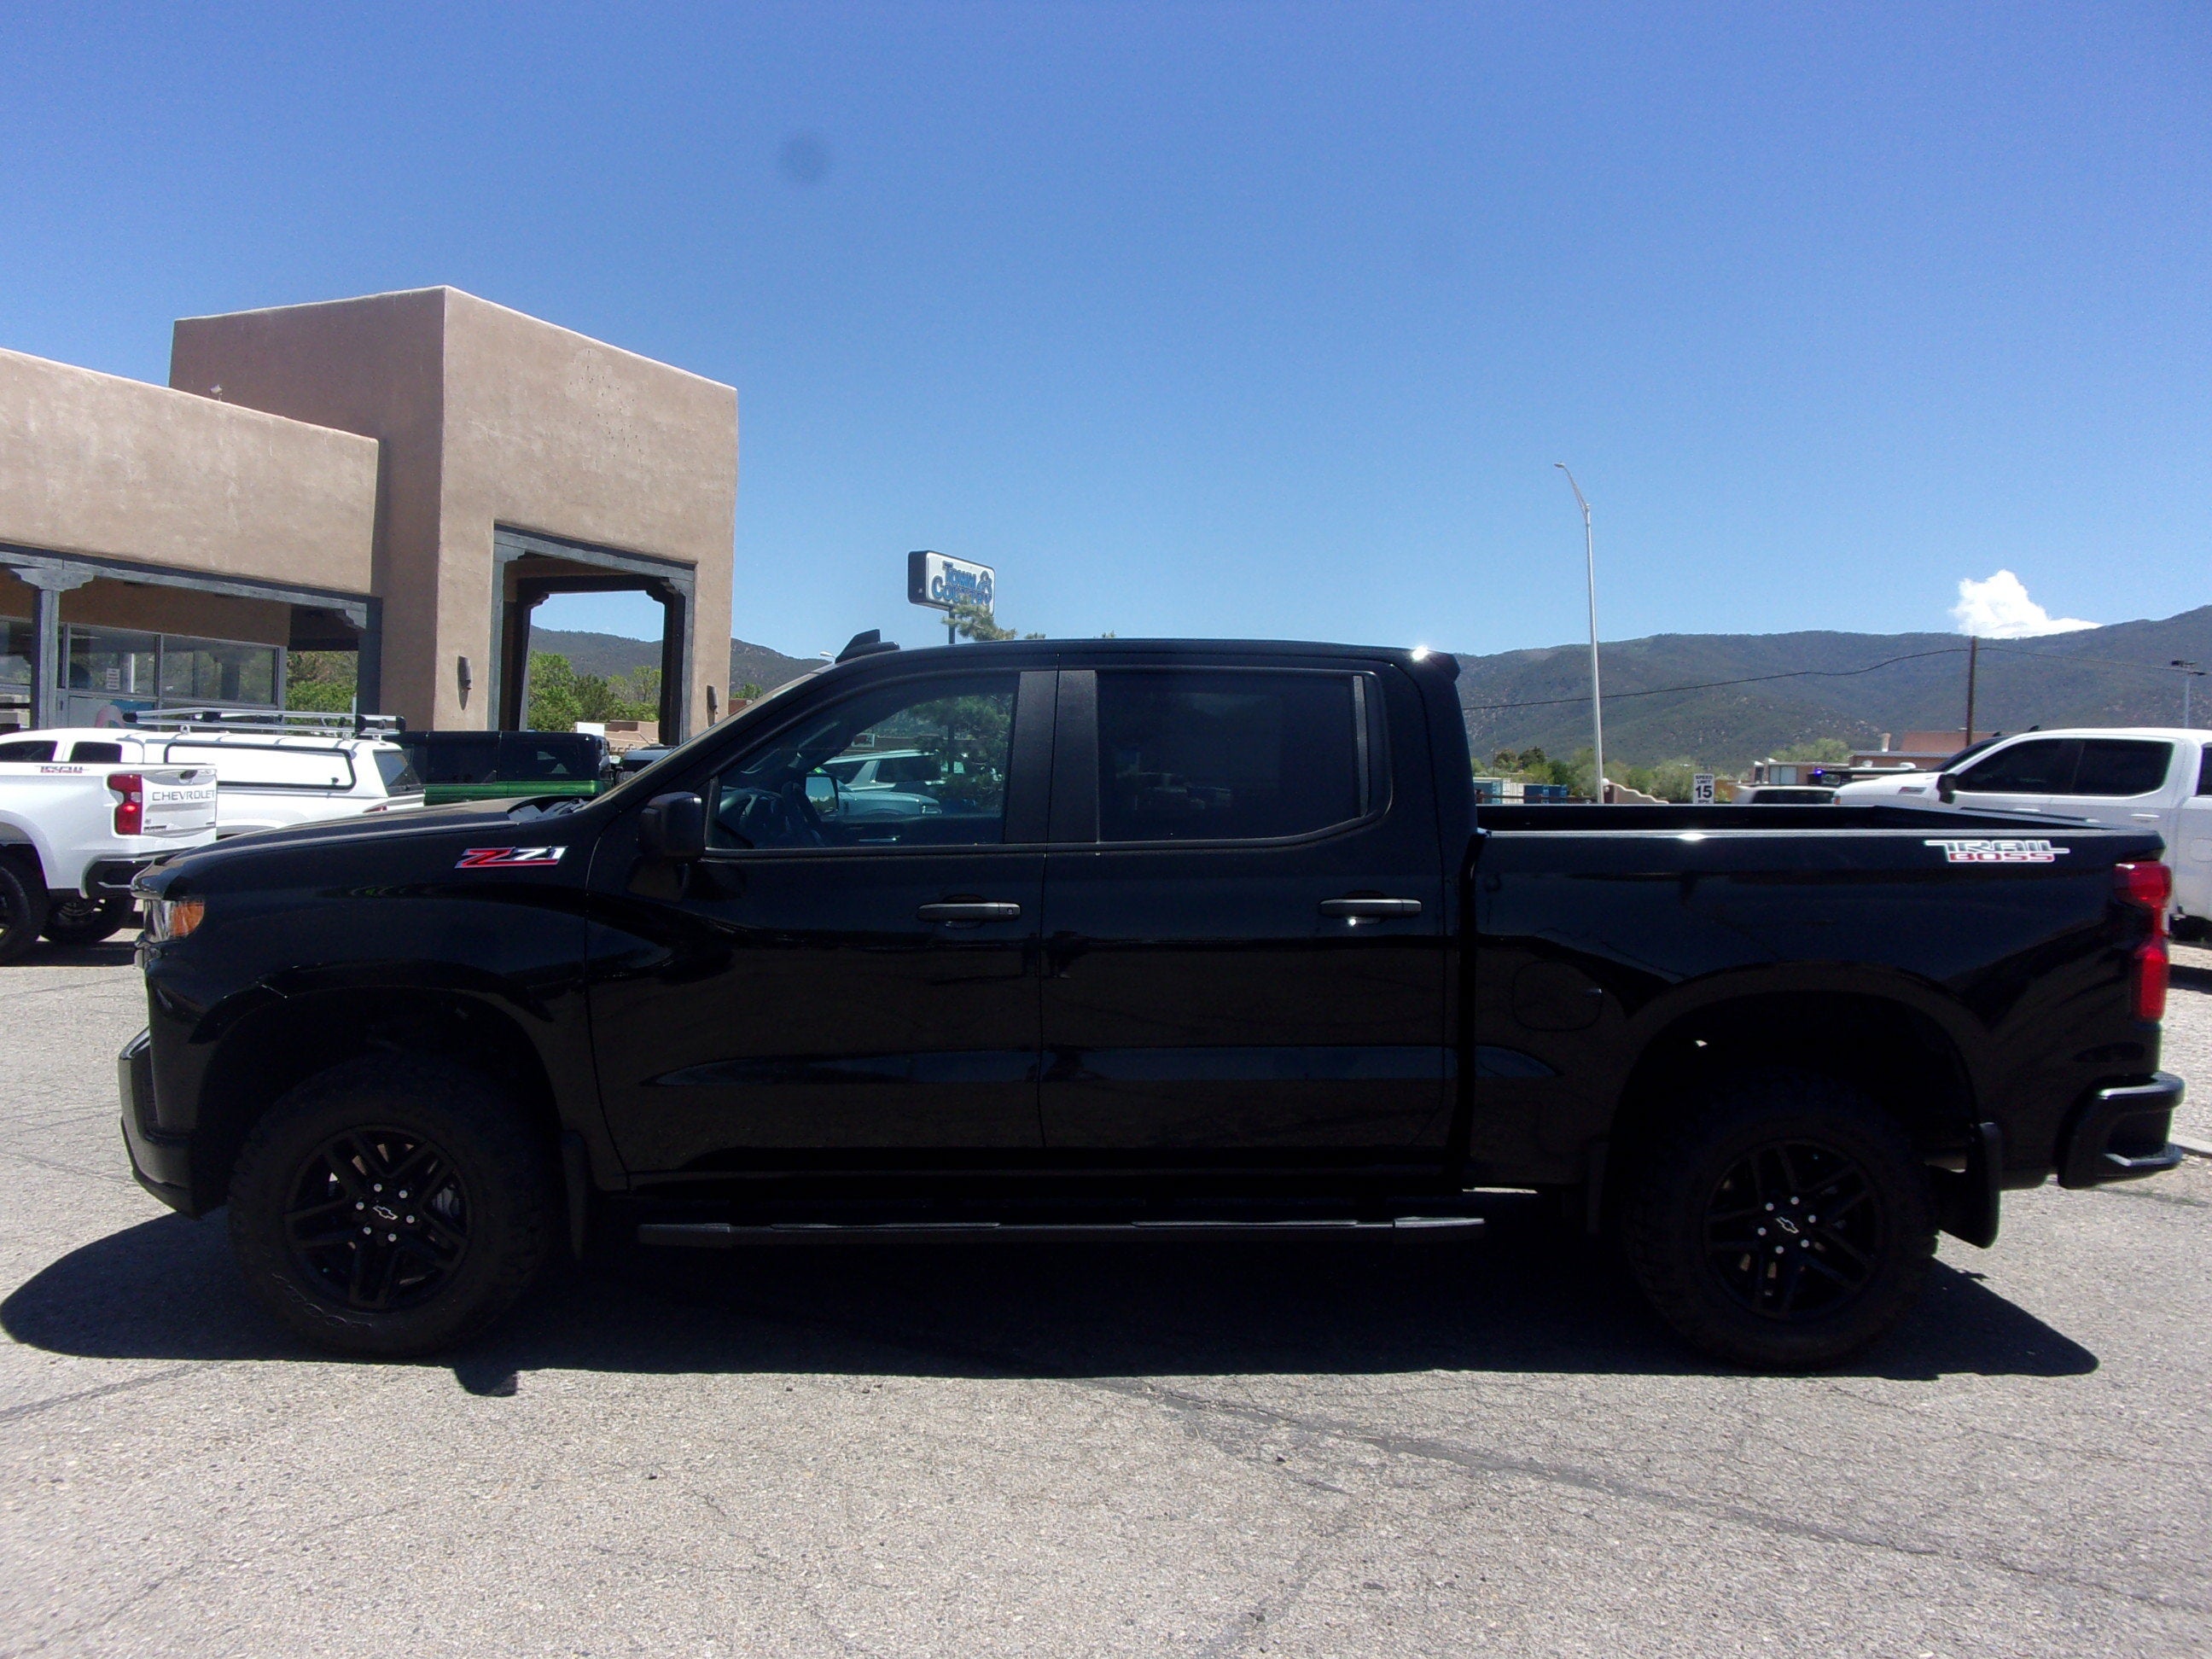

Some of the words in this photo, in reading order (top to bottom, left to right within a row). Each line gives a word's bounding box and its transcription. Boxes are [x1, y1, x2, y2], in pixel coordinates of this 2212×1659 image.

[152, 789, 215, 801] CHEVROLET
[1695, 785, 1713, 799] 15
[1924, 839, 2070, 853] TRAIL
[454, 845, 569, 870] Z71
[1947, 852, 2055, 863] BOSS
